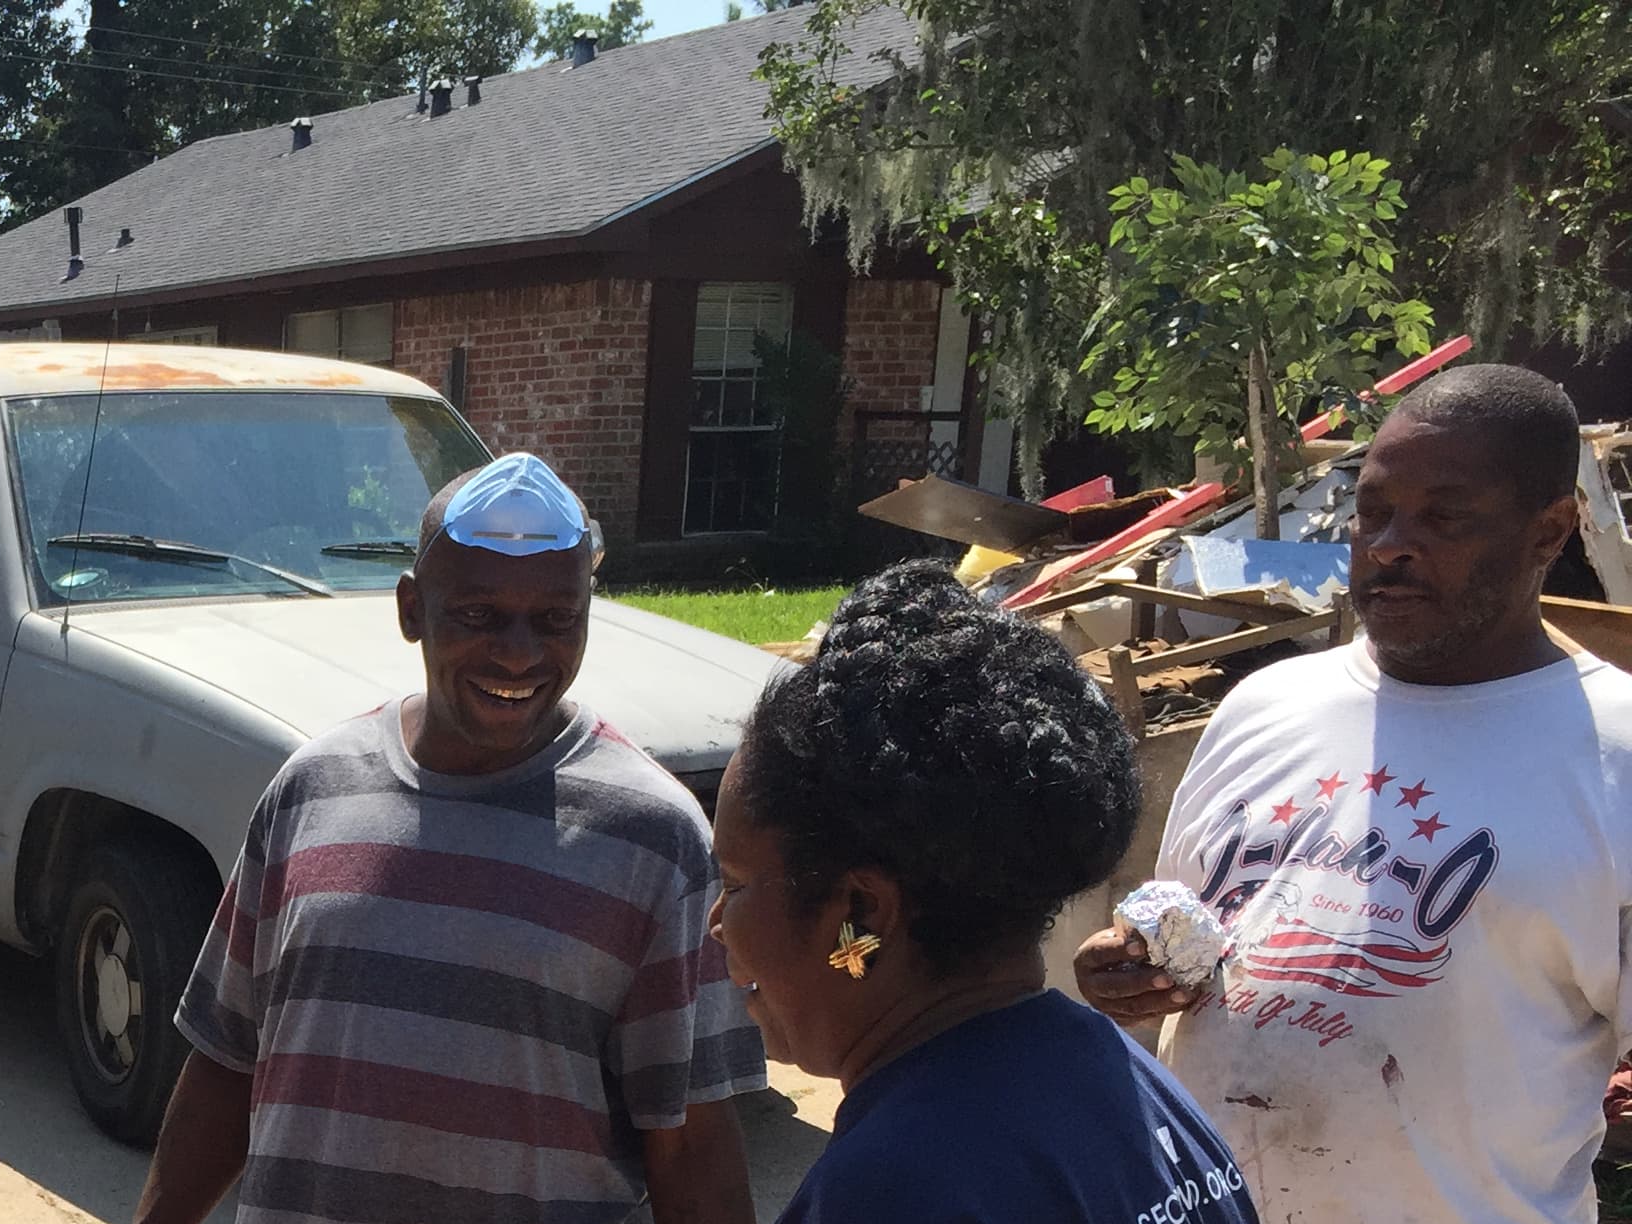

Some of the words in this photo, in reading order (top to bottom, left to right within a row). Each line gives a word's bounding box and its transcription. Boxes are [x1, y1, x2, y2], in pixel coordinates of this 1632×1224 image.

[1311, 893, 1352, 914] Since
[1357, 902, 1404, 923] 1960
[1288, 1001, 1354, 1047] July
